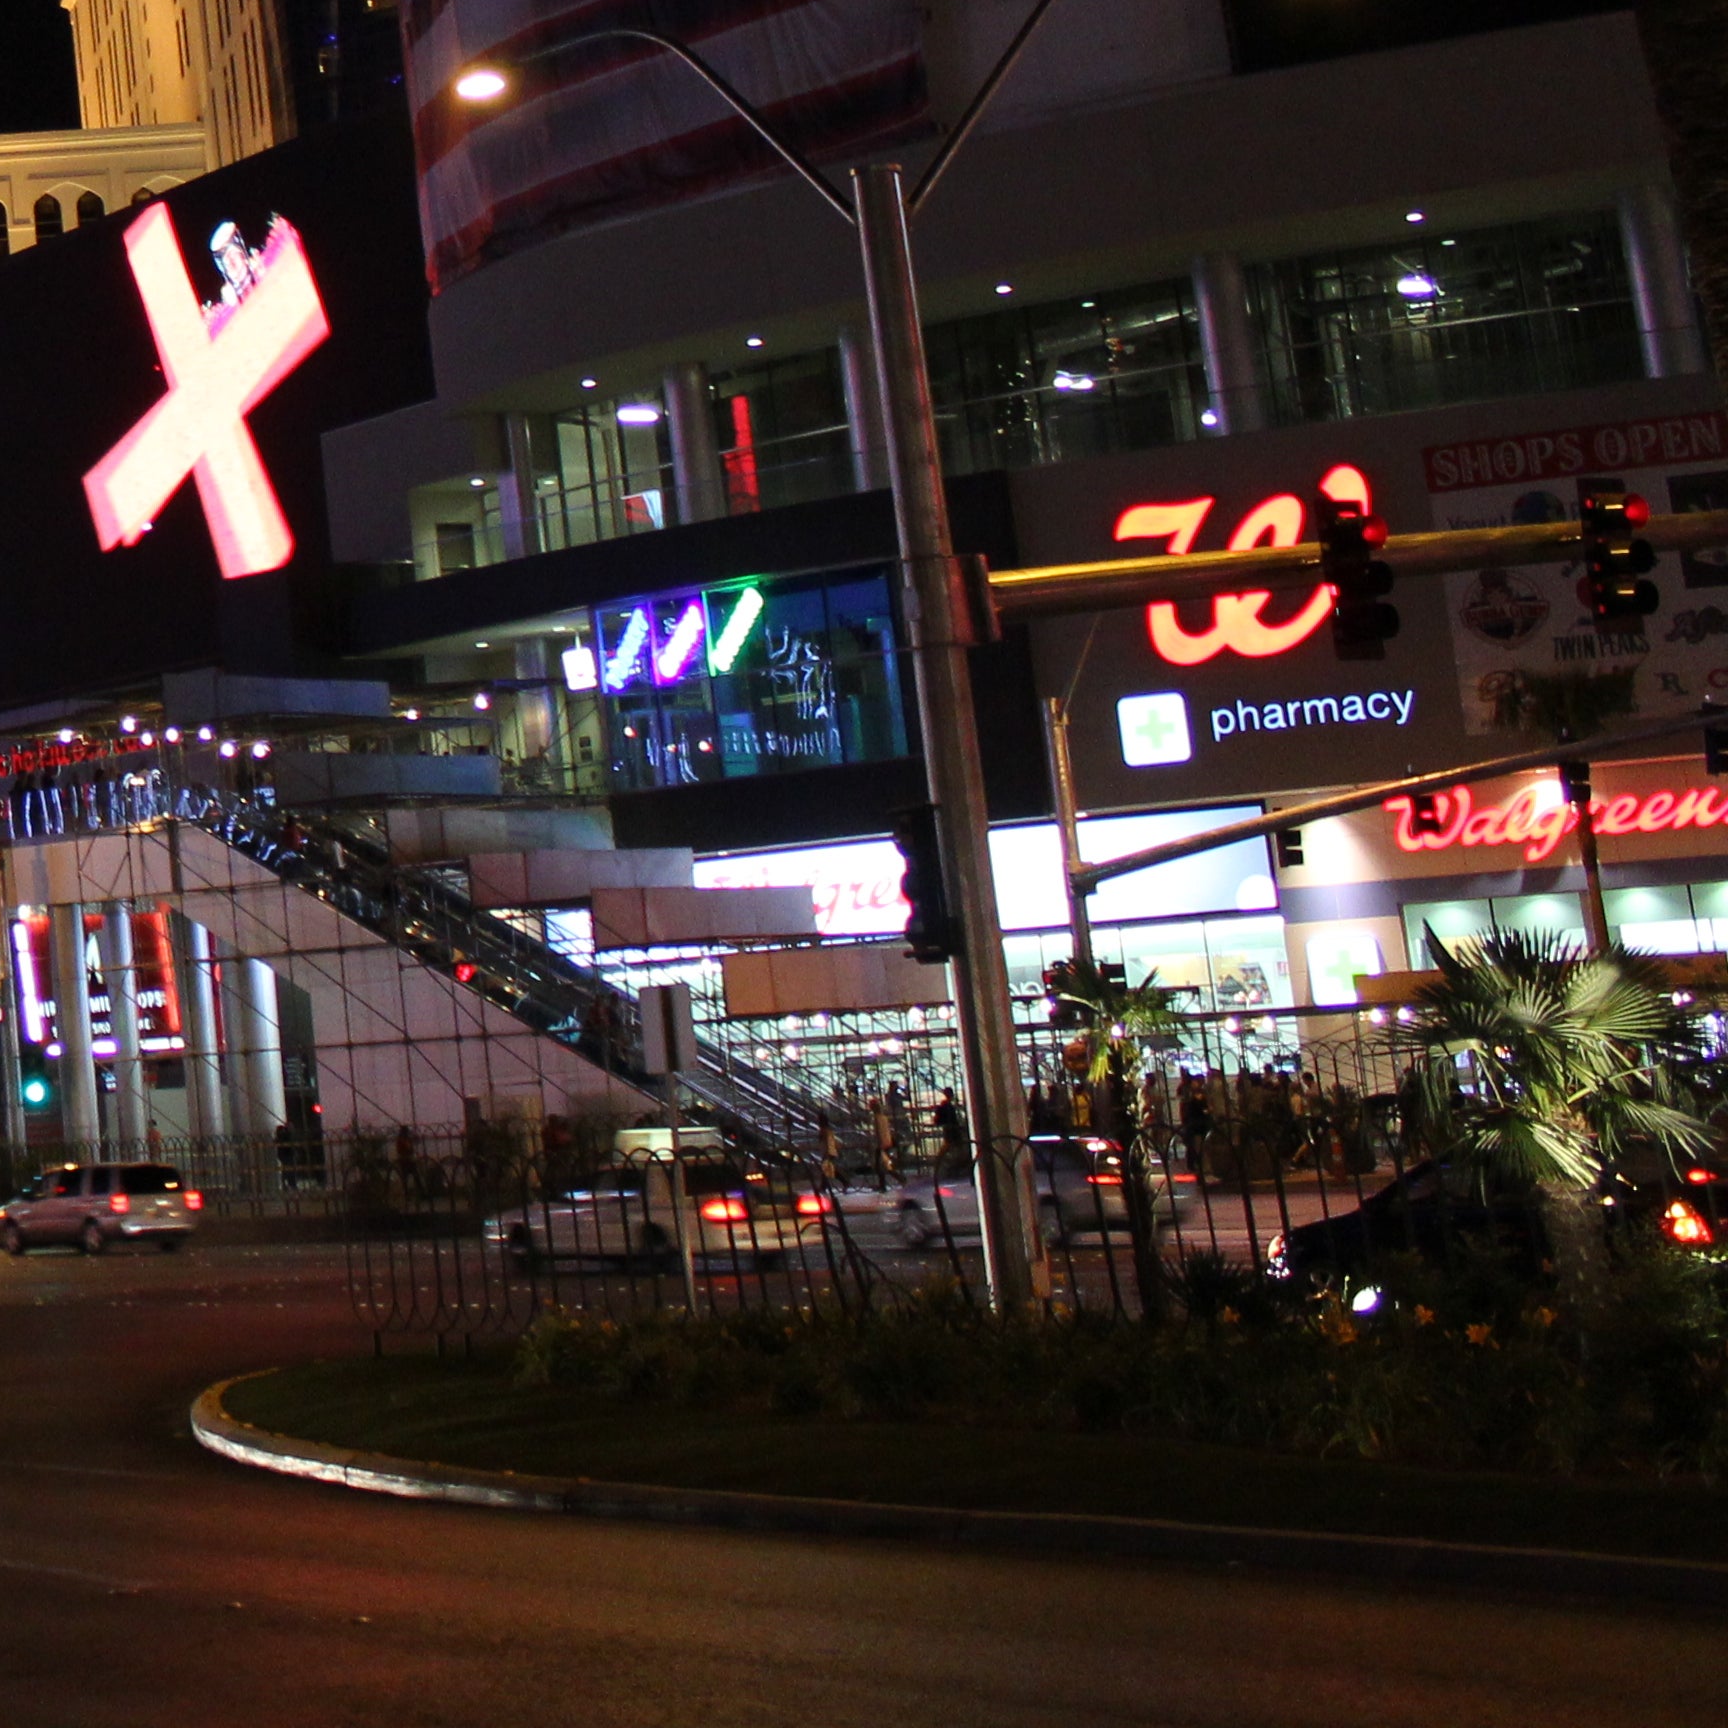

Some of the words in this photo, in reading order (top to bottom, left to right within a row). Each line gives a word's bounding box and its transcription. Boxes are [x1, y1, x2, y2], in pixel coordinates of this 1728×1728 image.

[1431, 432, 1585, 487] SHOPS
[1597, 416, 1721, 467] OPEN
[1210, 689, 1414, 742] pharmacy
